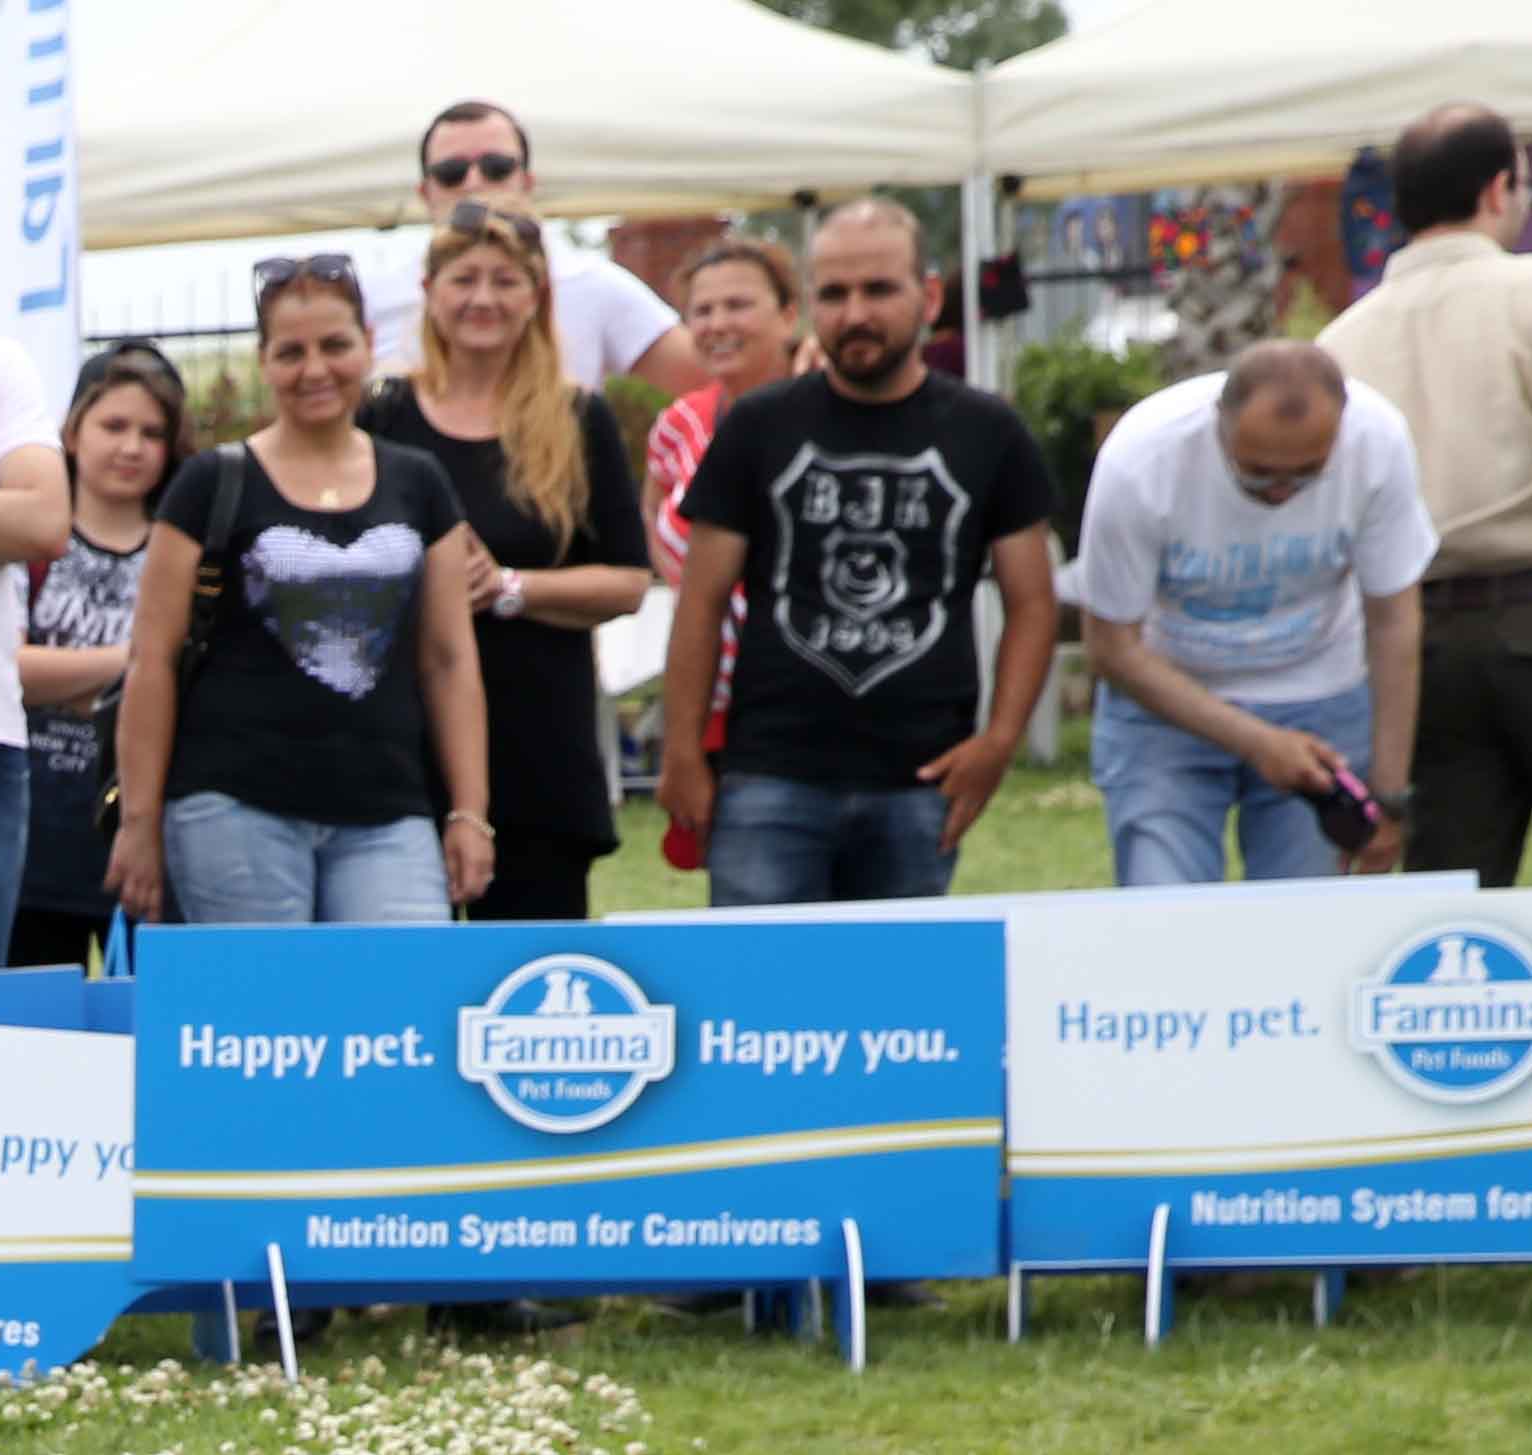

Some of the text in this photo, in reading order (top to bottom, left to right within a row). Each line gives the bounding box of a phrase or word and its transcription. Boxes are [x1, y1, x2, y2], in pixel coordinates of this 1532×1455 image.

[801, 470, 931, 529] BJK
[481, 1022, 651, 1064] Farmina
[700, 1020, 960, 1074] Happy you.
[1057, 997, 1321, 1051] Happy pet.
[179, 1024, 436, 1078] Happy pet.
[518, 1077, 612, 1100] Pet Foods
[307, 1211, 821, 1254] Nutrition System for Carnivores
[1191, 1189, 1341, 1225] Nutrition
[1351, 1187, 1478, 1230] System
